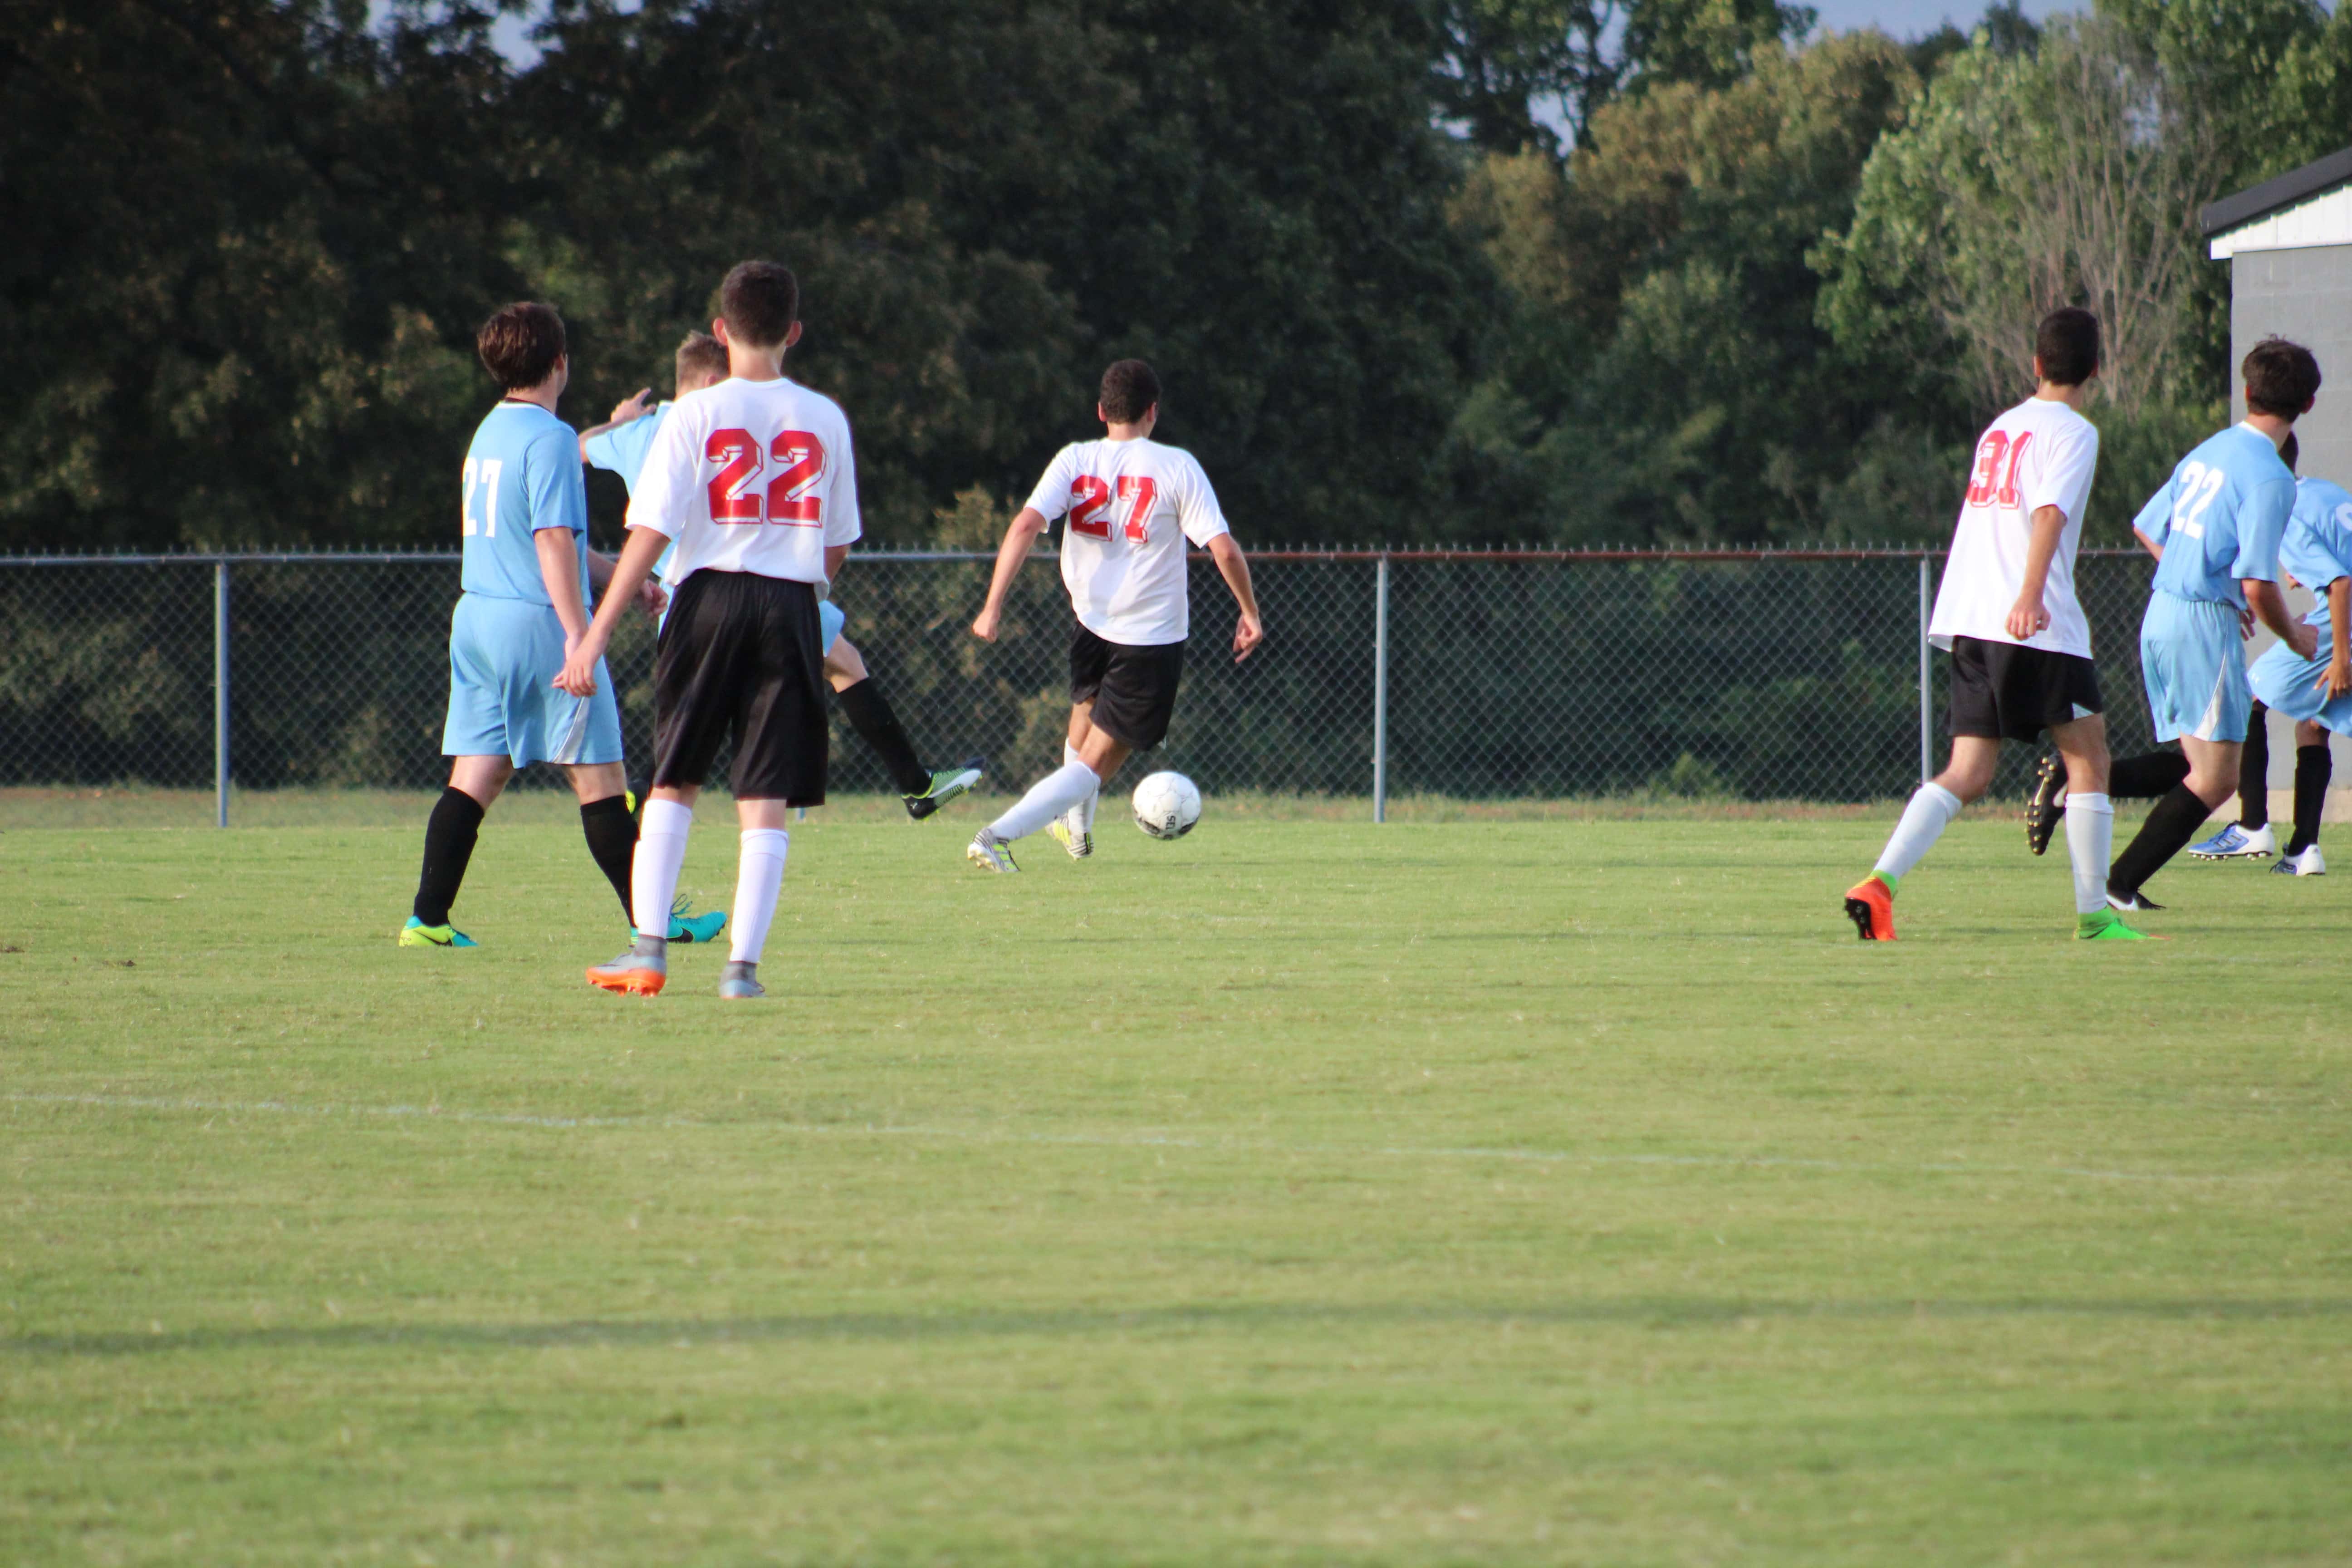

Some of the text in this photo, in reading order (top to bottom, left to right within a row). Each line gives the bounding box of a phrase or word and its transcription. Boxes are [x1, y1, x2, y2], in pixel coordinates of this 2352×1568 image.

[462, 457, 502, 538] 27
[706, 428, 827, 528] 22
[1966, 430, 2033, 509] 31
[2171, 461, 2225, 539] 22
[1069, 475, 1157, 544] 27
